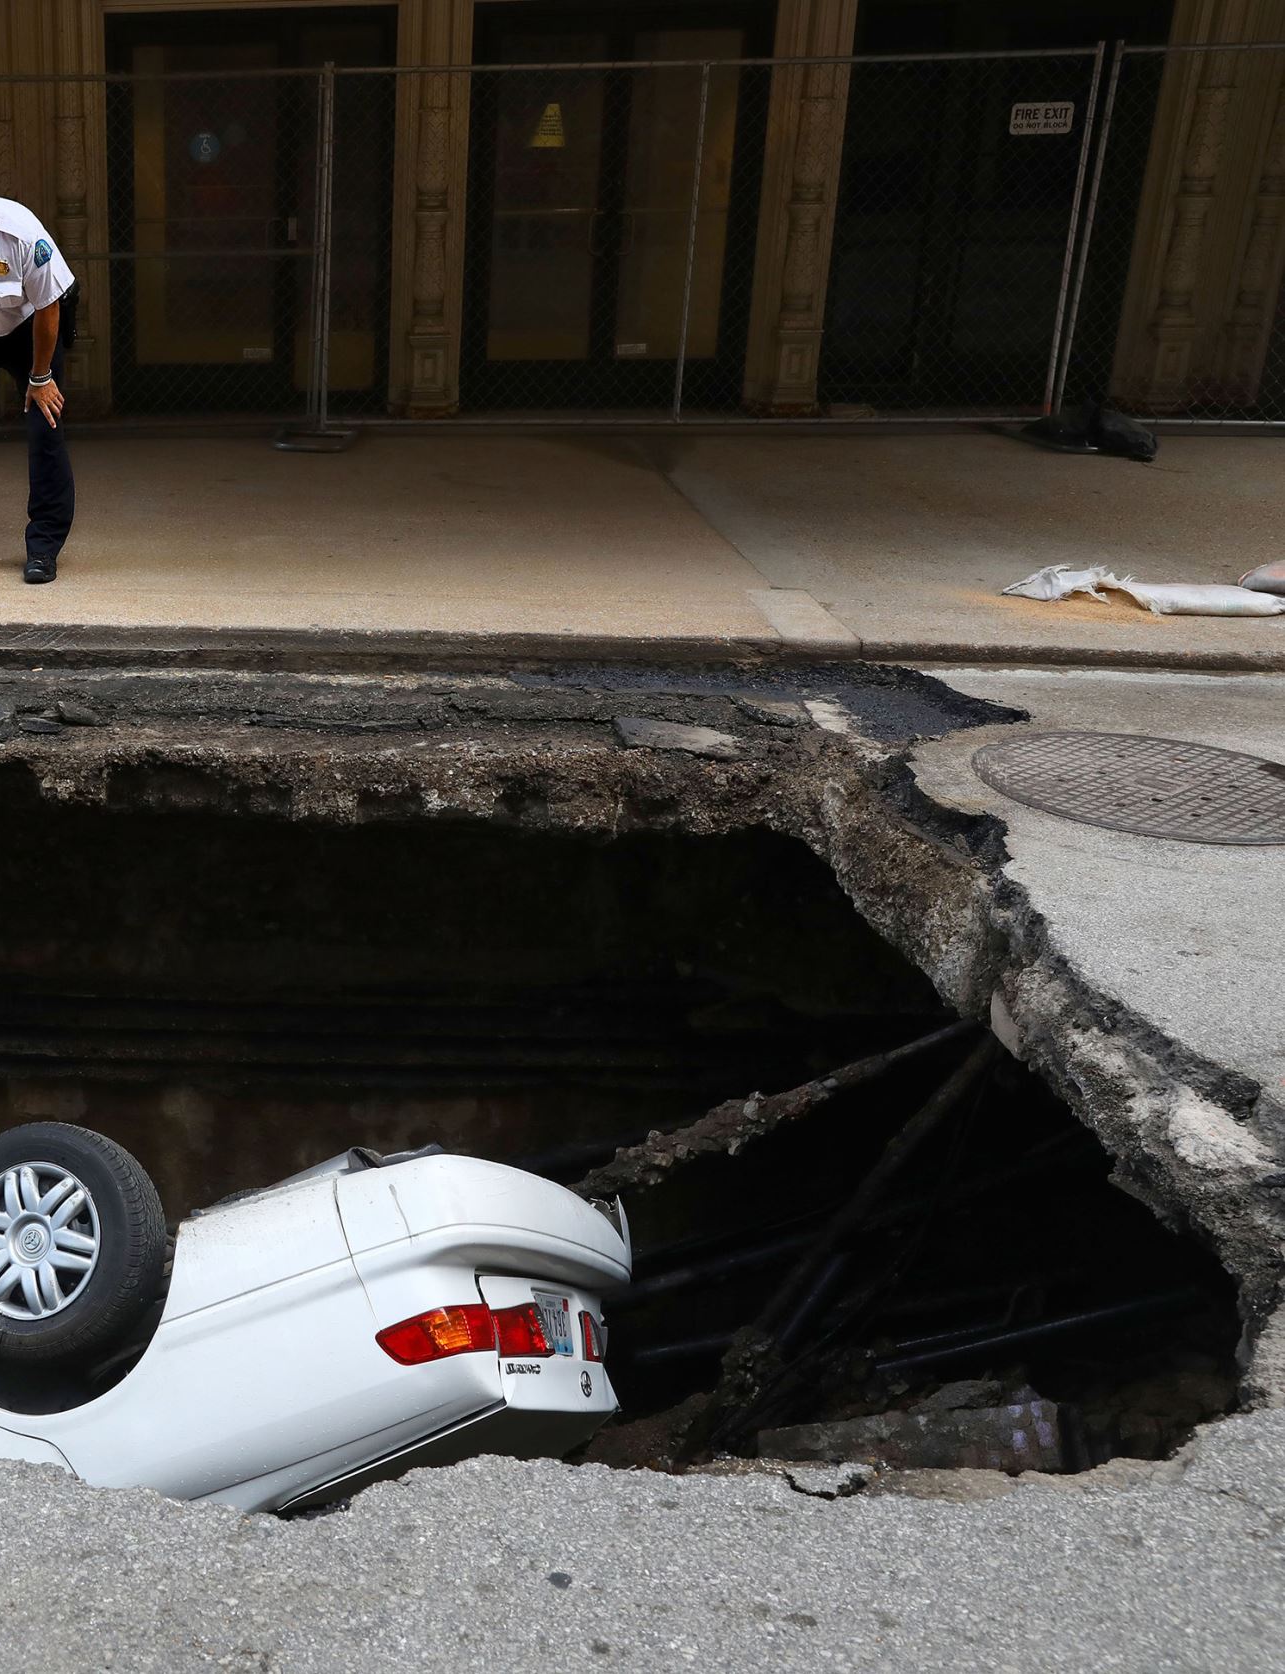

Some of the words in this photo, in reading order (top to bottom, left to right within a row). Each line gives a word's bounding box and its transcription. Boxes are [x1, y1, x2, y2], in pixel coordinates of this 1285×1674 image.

[1014, 108, 1040, 120] FIRE
[1044, 107, 1071, 120] EXIT
[1027, 121, 1041, 129] NOT
[1043, 121, 1067, 129] BLOCK
